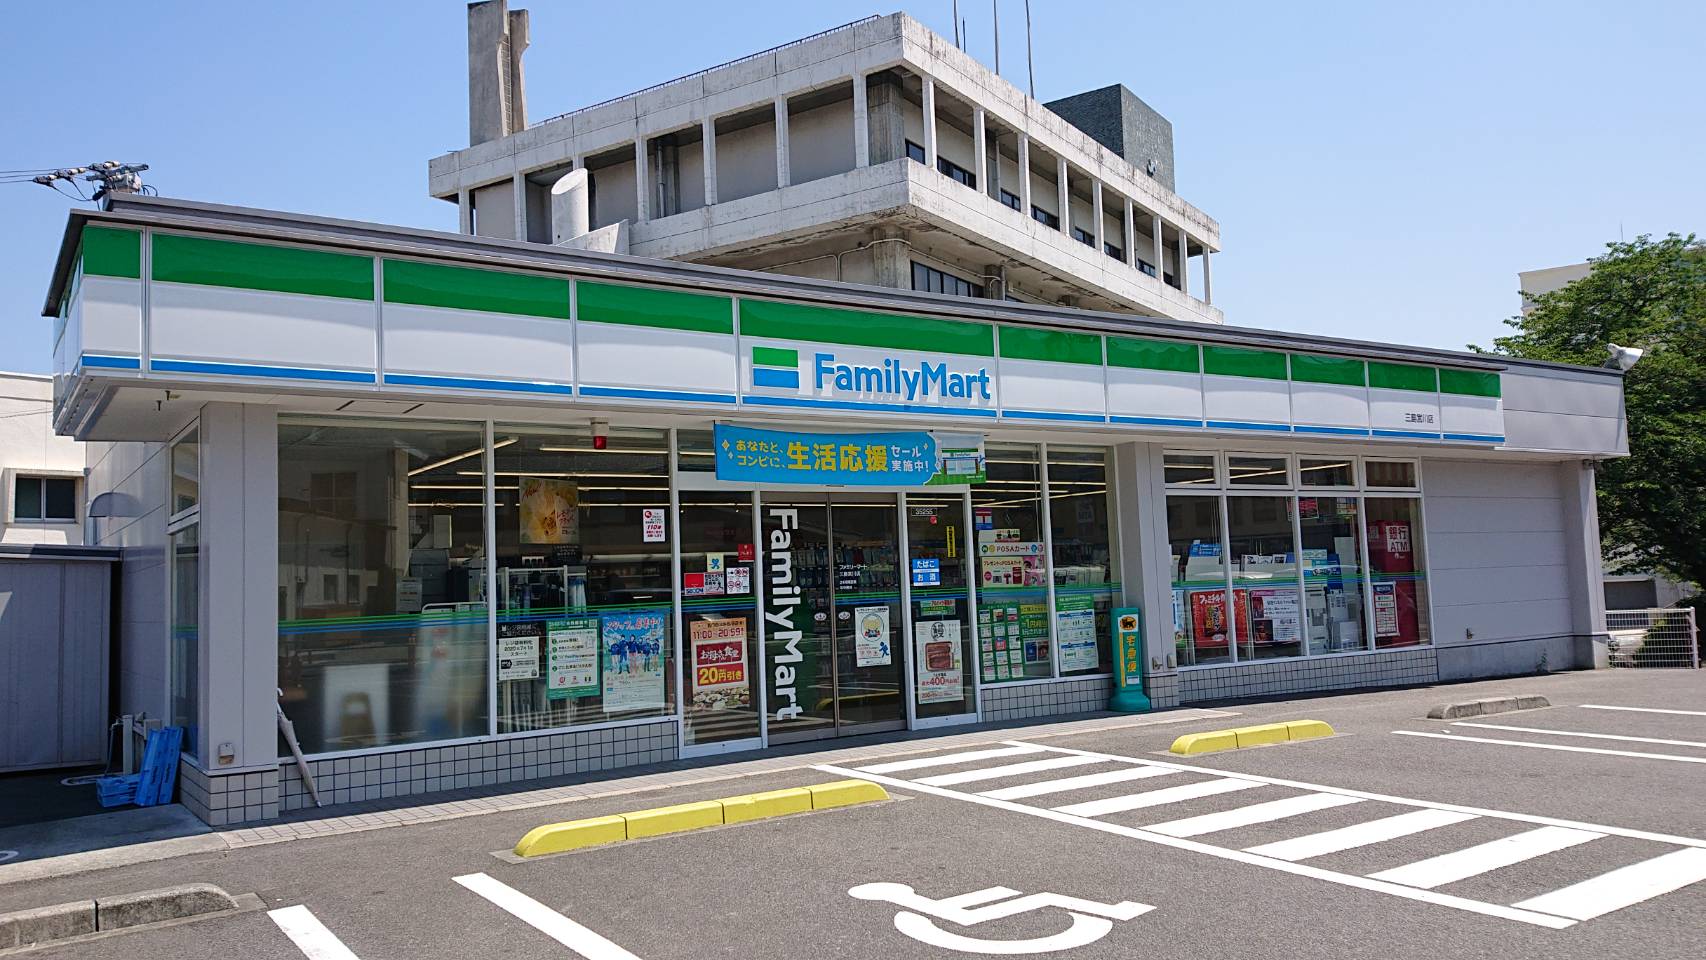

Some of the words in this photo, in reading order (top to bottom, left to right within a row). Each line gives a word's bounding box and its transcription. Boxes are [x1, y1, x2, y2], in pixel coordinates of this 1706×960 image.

[815, 352, 991, 401] FamilyMart
[735, 440, 785, 454] あなたと、
[891, 444, 923, 458] セール
[736, 454, 786, 468] コンビに、
[786, 441, 888, 473] 生活応援
[891, 459, 929, 473] 実施中!
[1390, 541, 1408, 551] ATM
[916, 560, 936, 569] たばこ
[765, 508, 803, 721] FamilyMart
[699, 667, 743, 685] 20円引き
